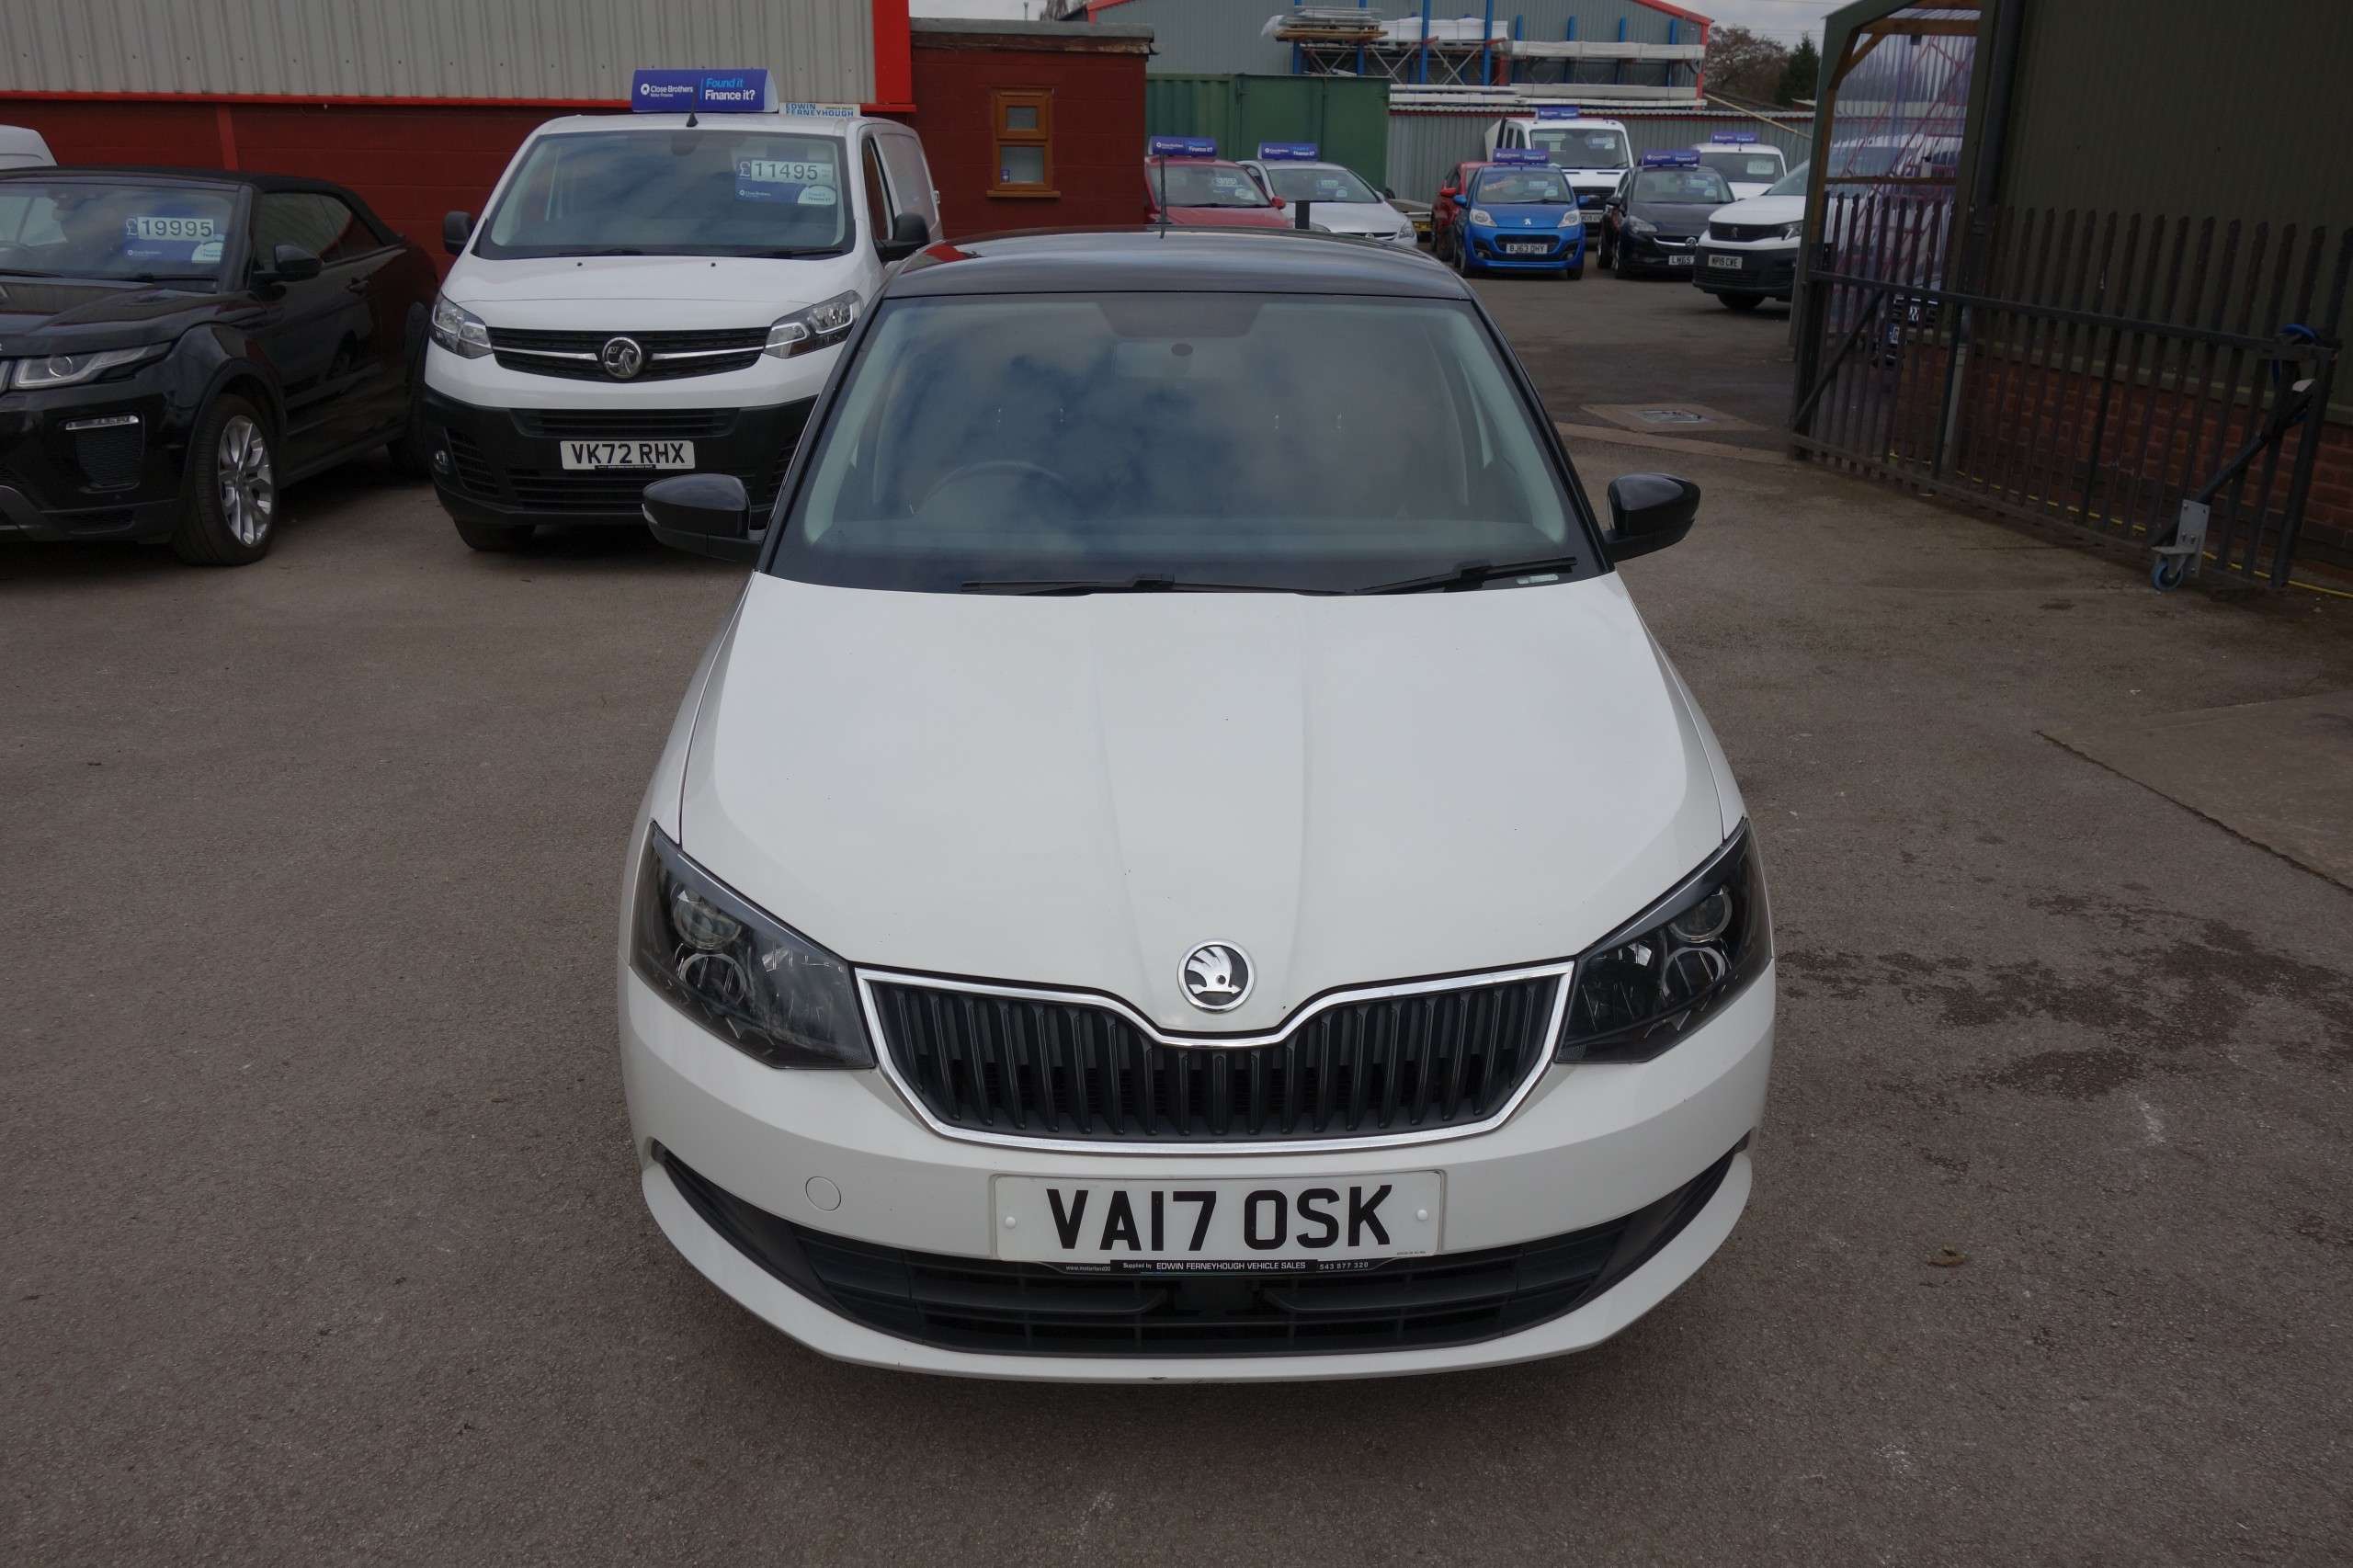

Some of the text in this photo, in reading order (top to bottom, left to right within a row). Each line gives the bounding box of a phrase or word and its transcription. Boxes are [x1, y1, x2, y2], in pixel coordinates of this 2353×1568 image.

[706, 78, 744, 87] Found it
[667, 85, 693, 93] Brothers
[705, 90, 756, 100] Finance it?
[571, 443, 686, 463] VK72 RHX
[1046, 1185, 1392, 1251] VA17 OSK
[1156, 1262, 1184, 1270] EDWIN
[1186, 1262, 1245, 1270] FERNEYHOUGH
